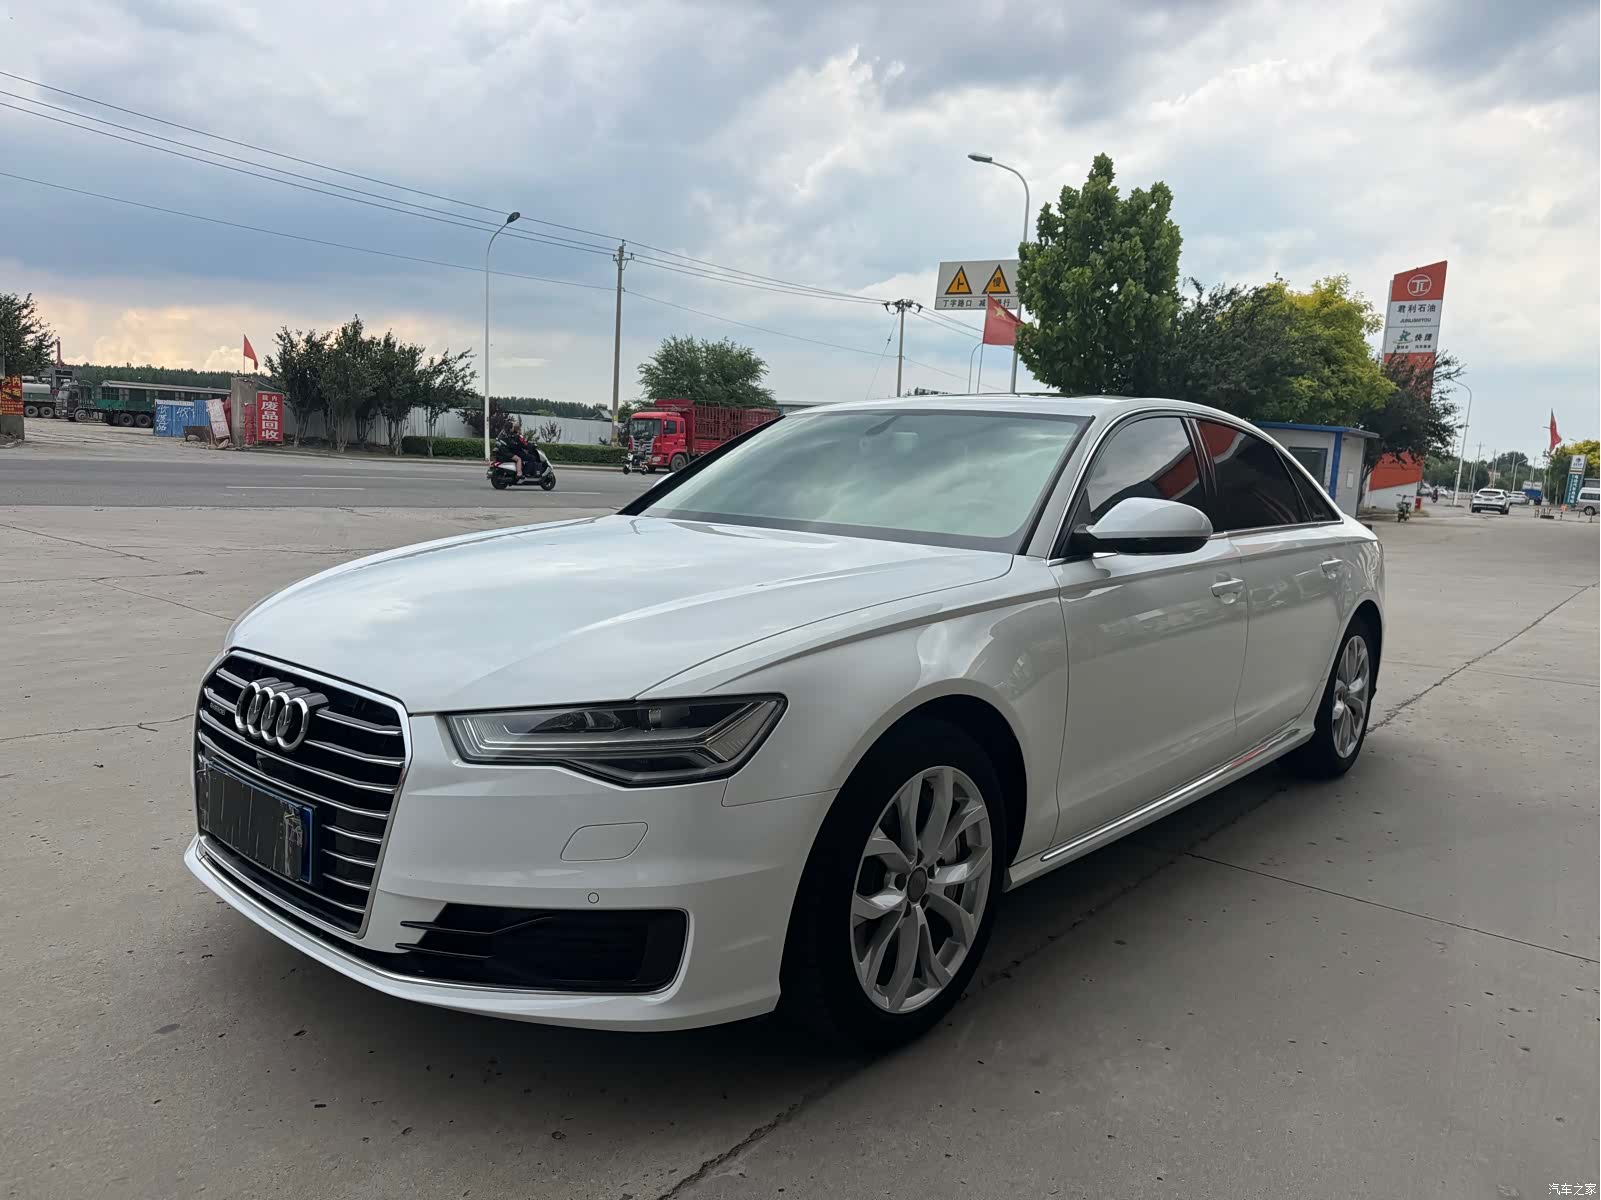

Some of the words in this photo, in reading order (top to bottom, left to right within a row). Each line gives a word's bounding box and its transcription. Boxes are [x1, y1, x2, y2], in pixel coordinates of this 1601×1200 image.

[943, 299, 972, 307] 丁字路口
[979, 298, 1010, 307] 减行
[1397, 303, 1436, 313] 君利石油
[261, 401, 279, 440] 废品回收
